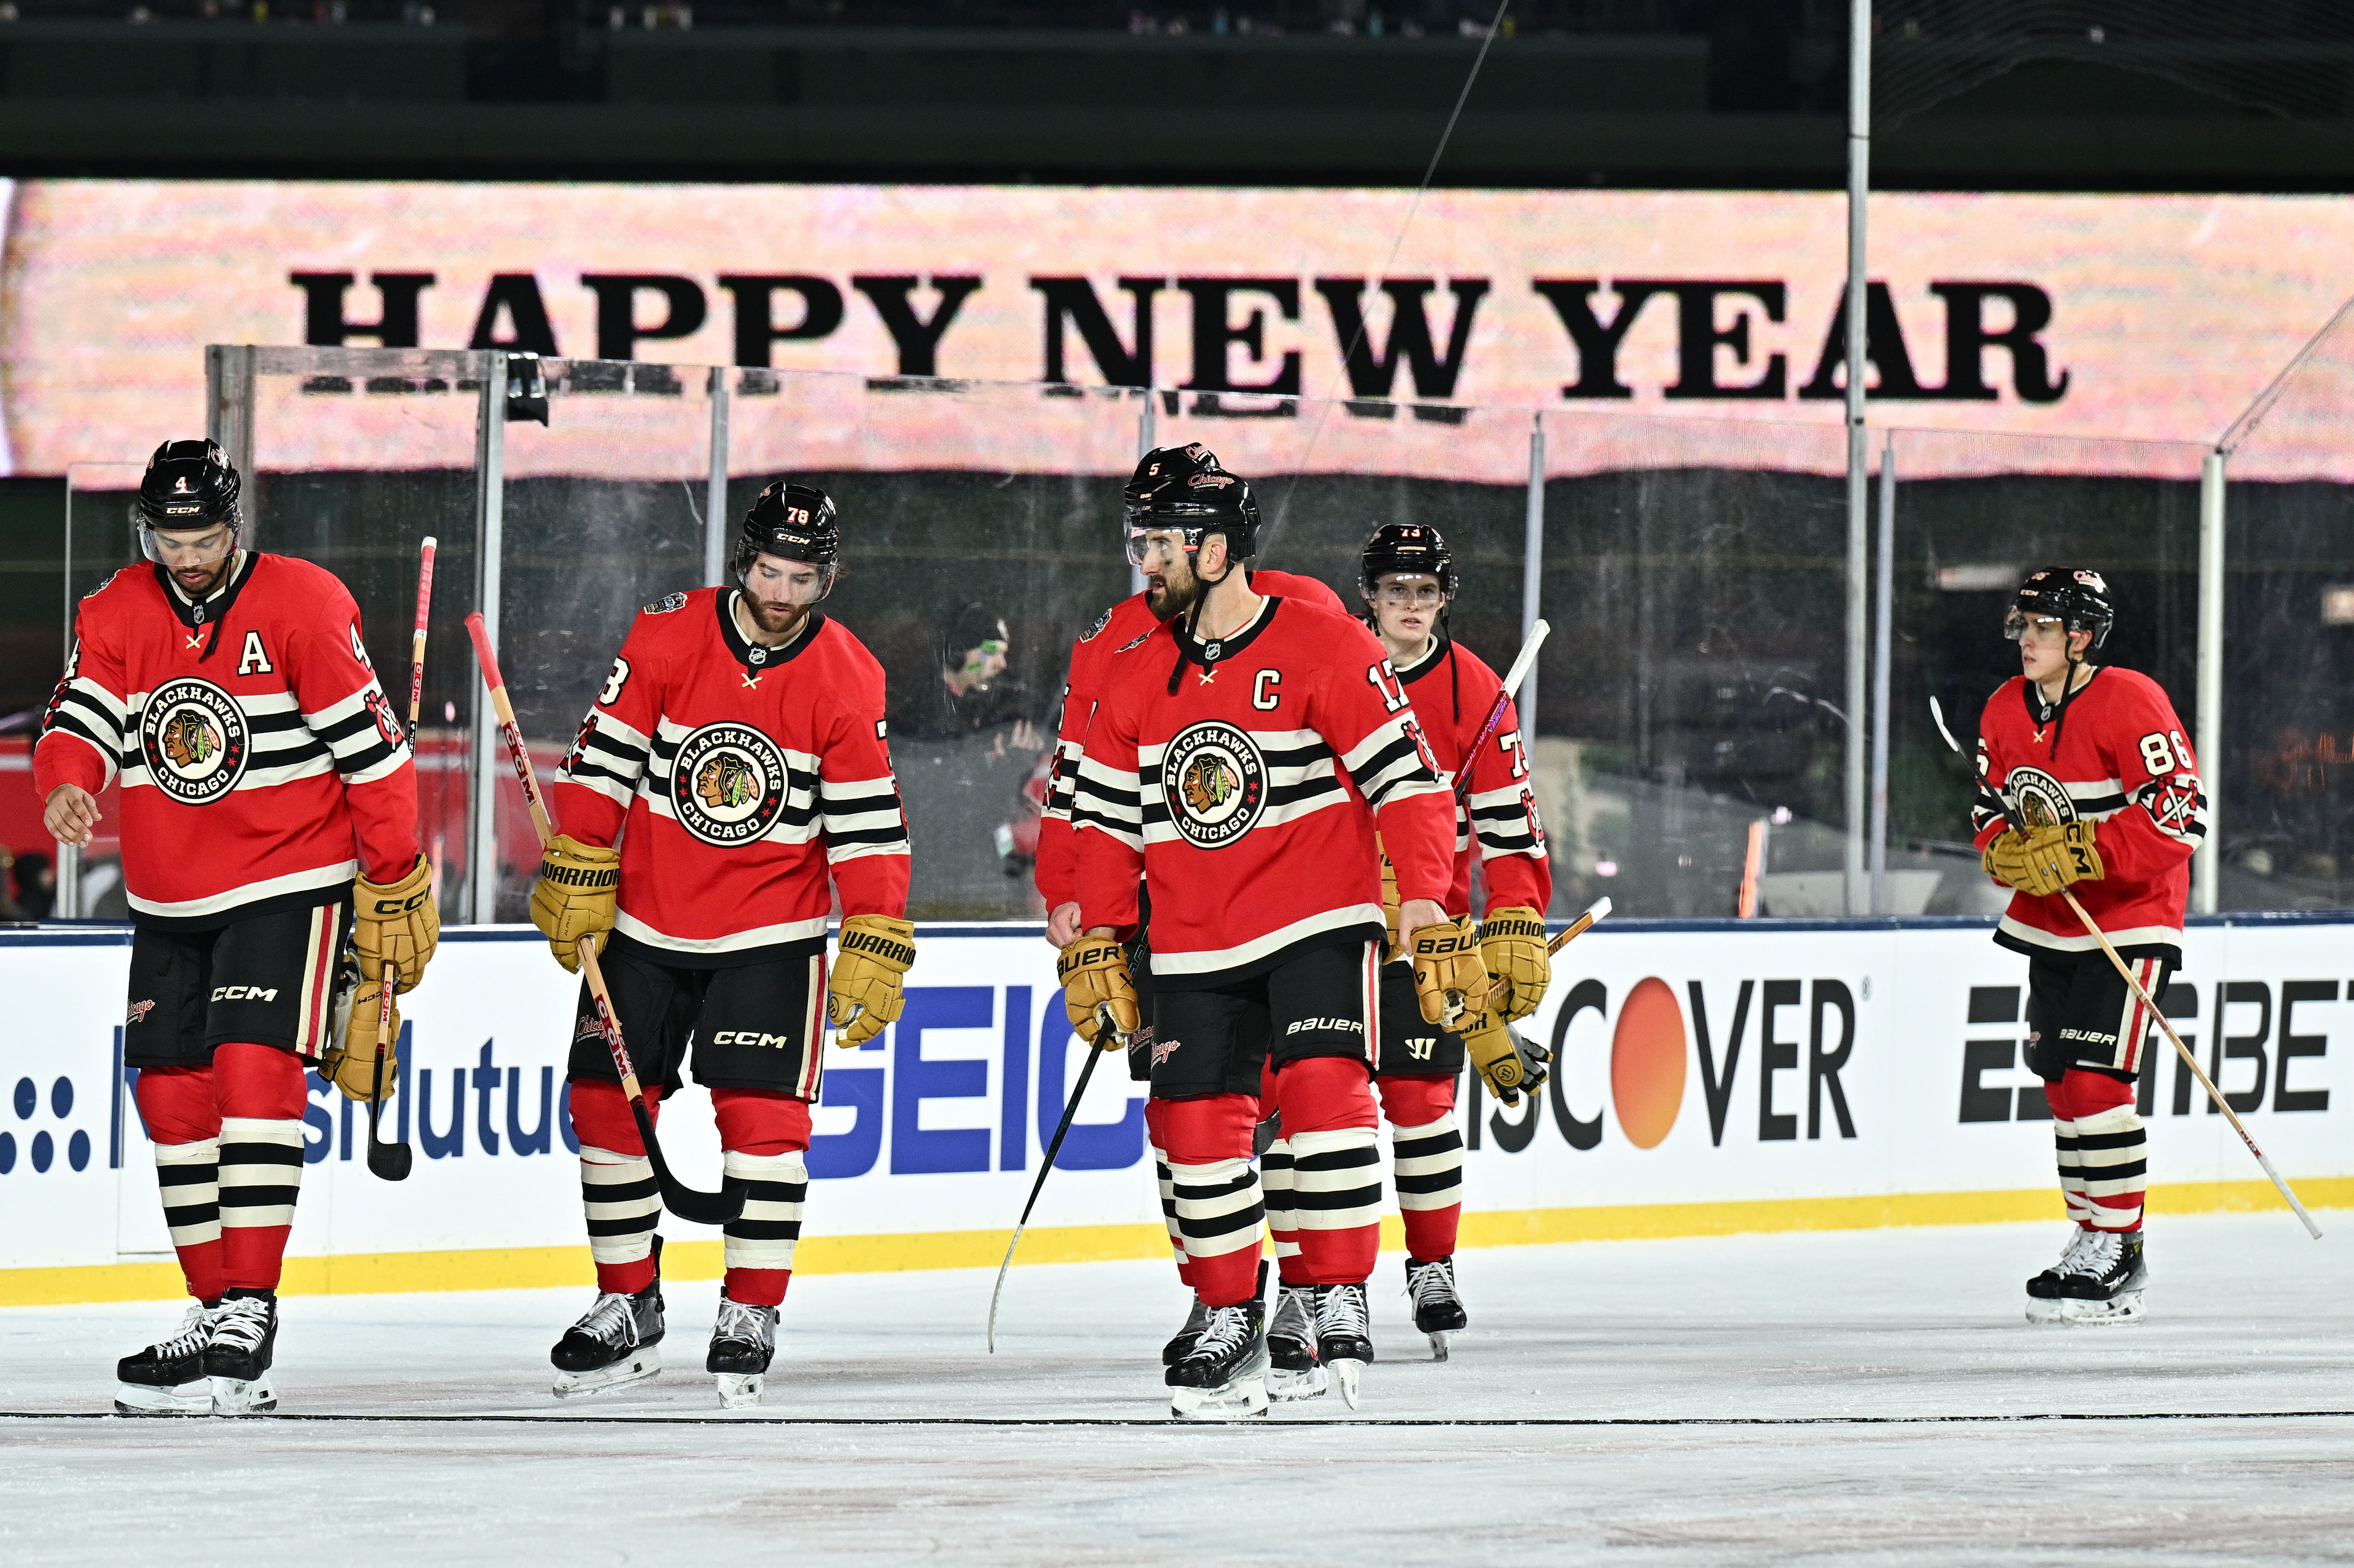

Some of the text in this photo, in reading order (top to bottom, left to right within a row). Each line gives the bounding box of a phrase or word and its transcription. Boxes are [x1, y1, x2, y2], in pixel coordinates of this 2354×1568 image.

[290, 272, 2070, 423] HAPPY NEW YEAR
[175, 476, 187, 493] 4
[1149, 463, 1162, 476] 5
[1188, 473, 1235, 489] Chicago
[788, 506, 809, 525] 78
[777, 532, 811, 545] CCM
[237, 630, 274, 677] A
[350, 622, 372, 672] 4
[412, 663, 422, 703] CCM
[597, 655, 632, 707] 8
[1252, 668, 1282, 711] C
[1367, 658, 1411, 715] 17
[145, 686, 240, 738] BLACKHAWKS
[506, 727, 537, 805] CCM
[680, 731, 781, 790] BLACKHAWKS
[1167, 730, 1257, 786] BLACKHAWKS
[2138, 730, 2193, 776] 86
[158, 767, 229, 795] CHICAGO
[683, 802, 759, 838] CHICAGO
[1181, 808, 1249, 839] CHICAGO
[2067, 824, 2091, 873] CM
[542, 859, 620, 887] WARRIOR
[842, 930, 916, 967] WARRIO
[1416, 932, 1481, 954] BAUE
[1548, 936, 1564, 957] OVERT
[1057, 946, 1120, 982] AUER
[127, 999, 155, 1022] hicago
[211, 986, 278, 1002] CCM
[598, 1000, 630, 1080] CCM
[713, 1031, 788, 1049] CCM
[1286, 1017, 1363, 1036] BAUER
[2060, 1028, 2116, 1046] BAUER
[1151, 1040, 1181, 1063] hicago
[1454, 975, 1857, 1153] ICOVER
[2207, 979, 2354, 1115] BE
[807, 985, 1147, 1180] GEIC
